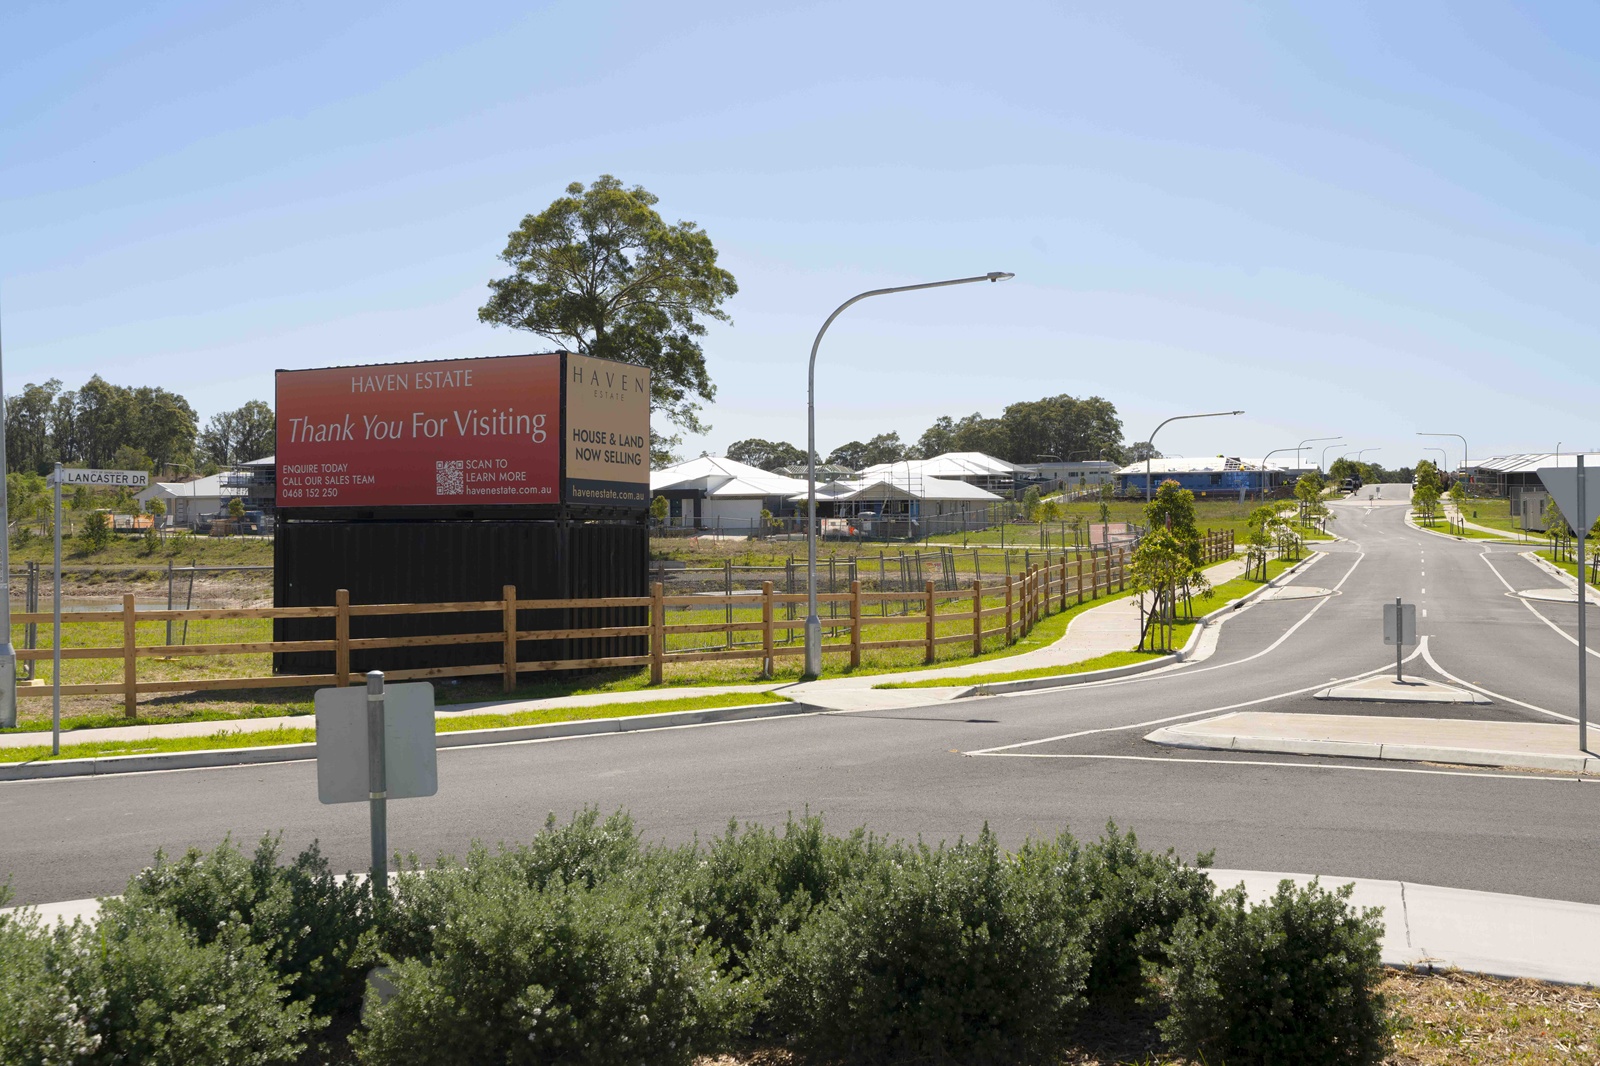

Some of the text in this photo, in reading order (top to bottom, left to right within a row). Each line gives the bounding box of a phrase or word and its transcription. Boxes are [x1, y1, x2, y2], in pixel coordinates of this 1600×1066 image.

[351, 369, 473, 393] HAVEN ESTATE
[573, 366, 644, 393] HAVEN
[594, 390, 625, 402] ESTATE
[289, 407, 547, 443] Thank You For Visiting
[573, 428, 644, 449] HOUSE & LAND
[575, 447, 642, 466] NOW SELLING
[282, 463, 348, 474] ENQUIRE TODAY
[465, 459, 508, 470] SCAN TO
[68, 473, 146, 485] LANCASTER DR
[282, 475, 375, 486] CALL OUR SALES TEAM
[466, 471, 527, 482] LEARN MORE
[282, 488, 338, 498] 0468 152 250
[466, 485, 552, 496] havenestate.com.au
[572, 485, 645, 501] havenestate.com.au
